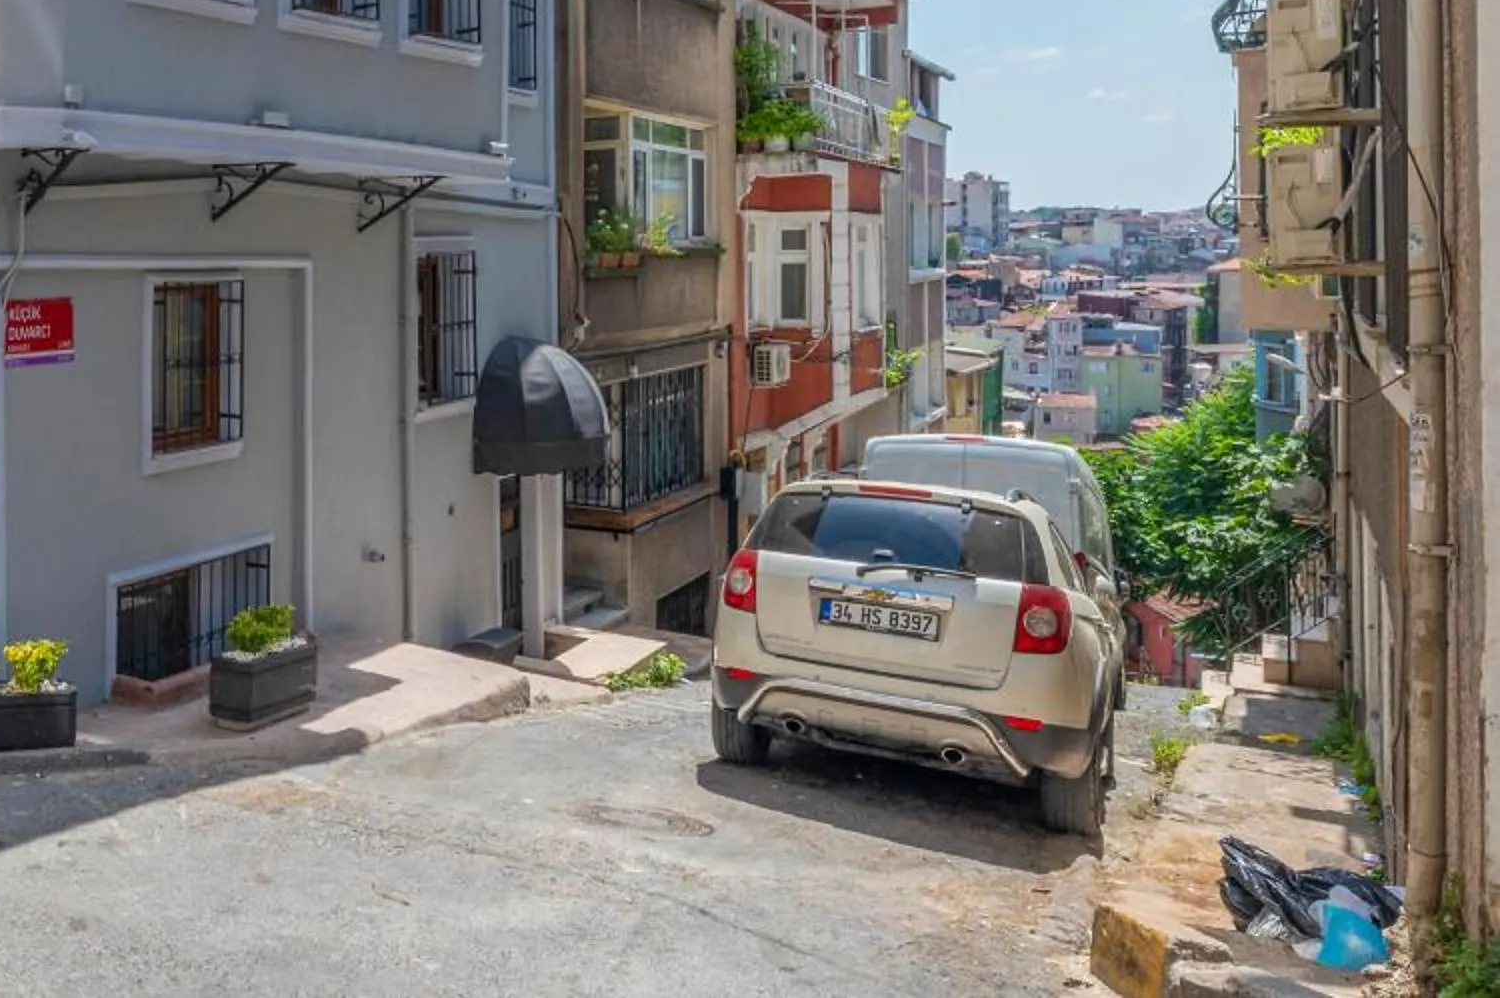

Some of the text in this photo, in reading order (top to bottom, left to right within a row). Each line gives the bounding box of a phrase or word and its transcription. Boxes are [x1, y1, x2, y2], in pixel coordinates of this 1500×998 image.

[832, 603, 852, 620] 34
[861, 606, 882, 625] HS
[889, 611, 933, 633] 8397
